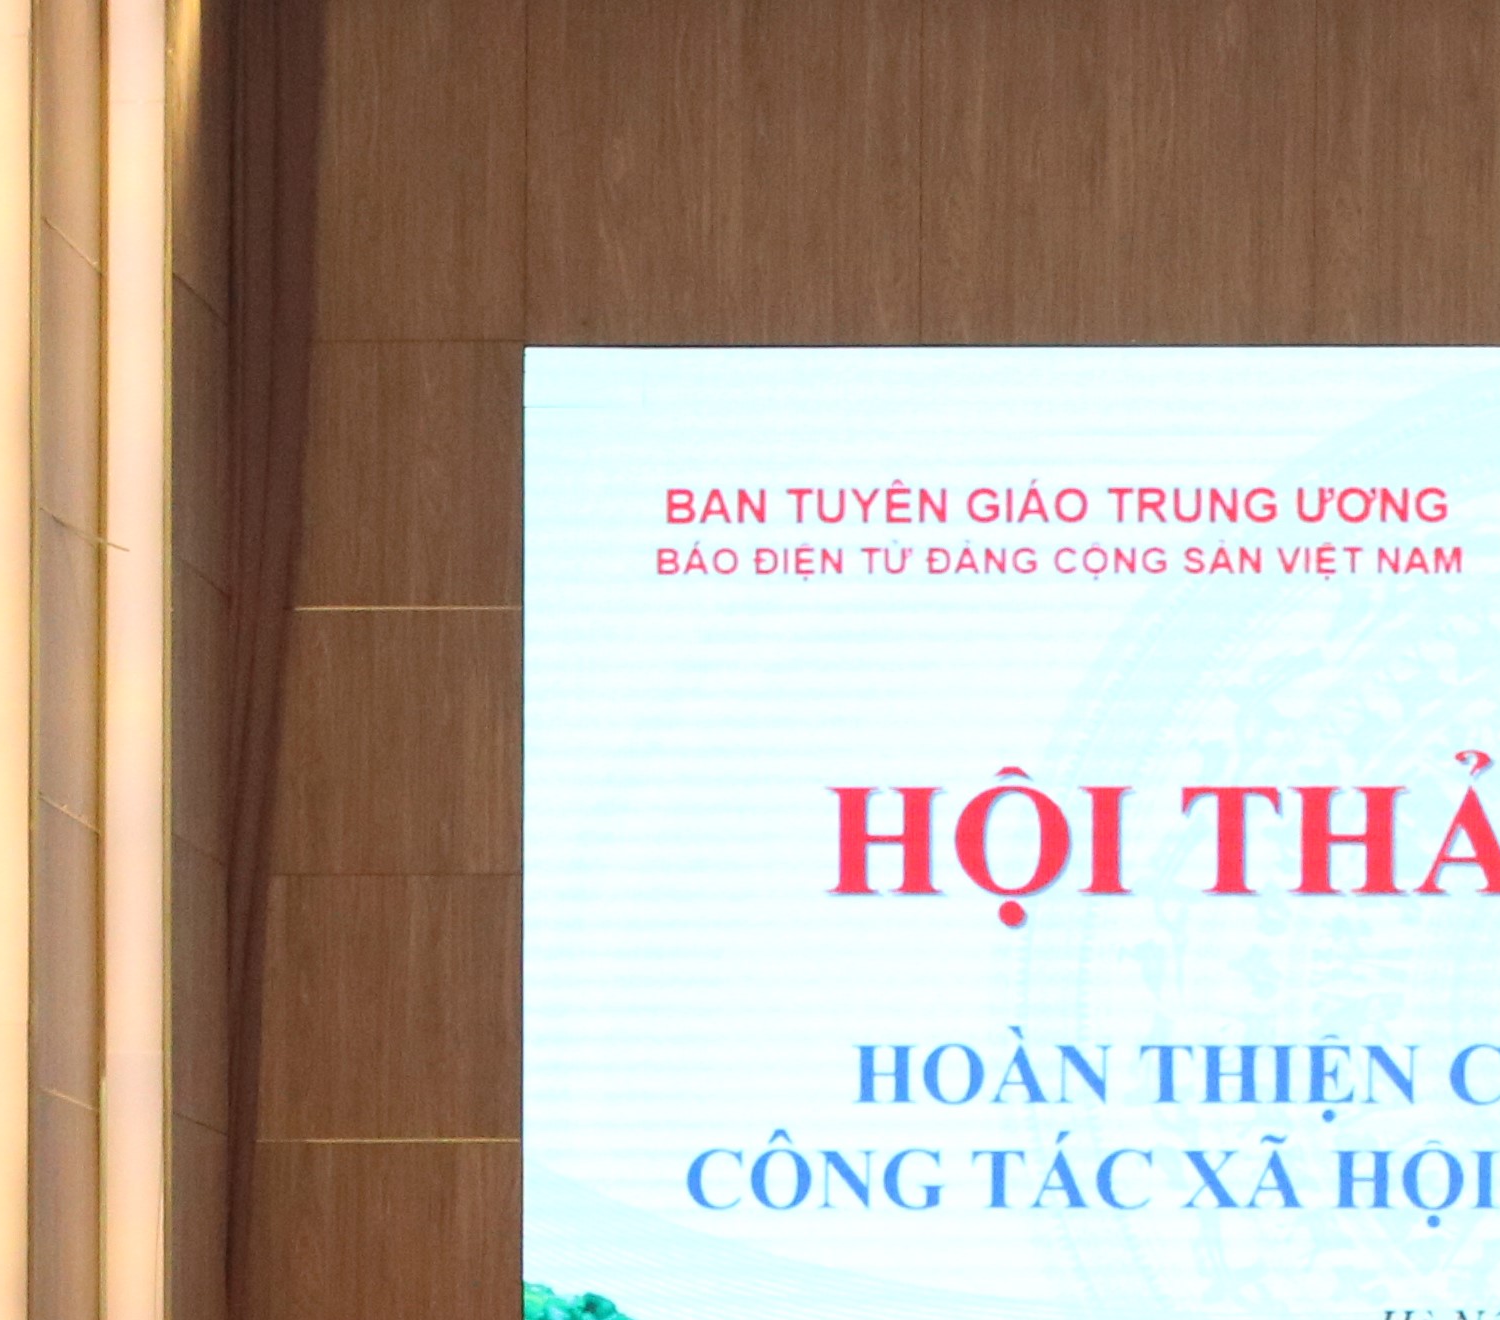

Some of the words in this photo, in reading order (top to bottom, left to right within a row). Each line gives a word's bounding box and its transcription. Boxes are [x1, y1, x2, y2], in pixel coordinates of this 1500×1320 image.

[665, 487, 767, 525] BAN
[786, 479, 948, 525] TUYÊN
[966, 479, 1089, 525] GIÁO
[1108, 486, 1278, 525] TRUNG
[1296, 485, 1450, 525] ƯƠNG
[656, 541, 739, 576] BÁO
[753, 543, 845, 581] ĐIỆN
[1054, 541, 1168, 581] CỘNG
[1277, 542, 1364, 581] VIỆT
[1377, 545, 1464, 575] NAM
[829, 765, 1132, 930] HỘI
[855, 1025, 1110, 1105] HOÀN
[1140, 1034, 1420, 1123] THIỆN
[685, 1129, 944, 1211] CÔNG
[971, 1130, 1155, 1211] TÁC
[1183, 1134, 1302, 1210] XÃ
[1336, 1140, 1497, 1229] HỘI
